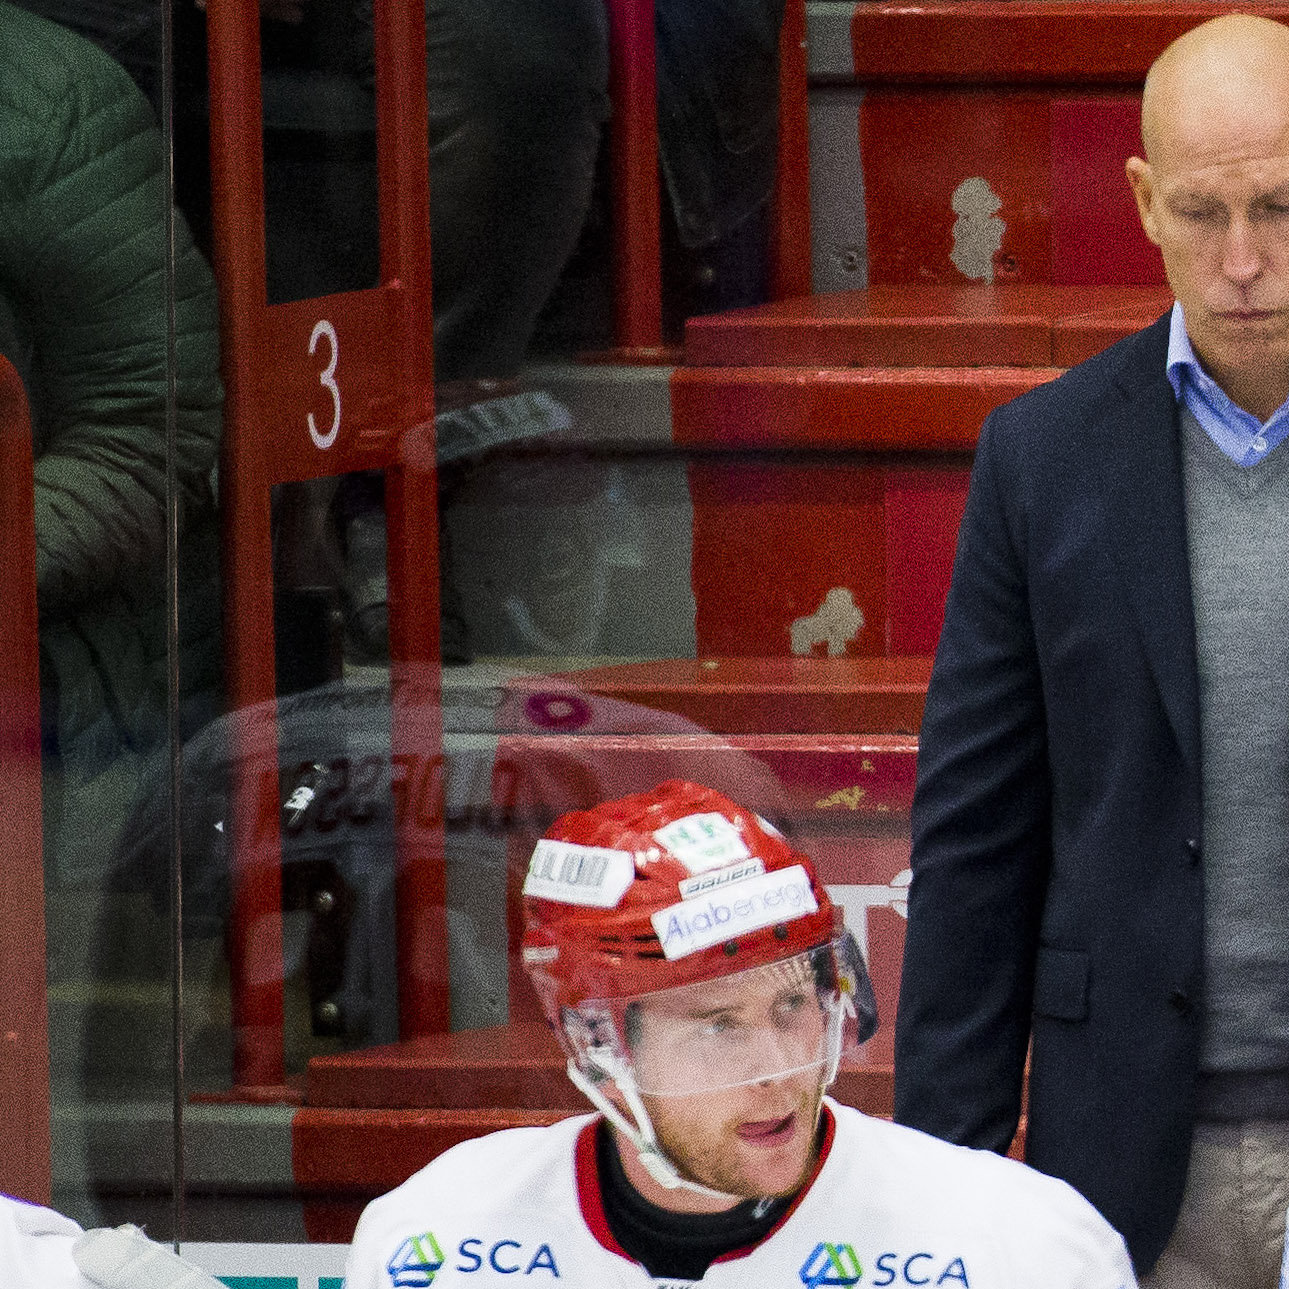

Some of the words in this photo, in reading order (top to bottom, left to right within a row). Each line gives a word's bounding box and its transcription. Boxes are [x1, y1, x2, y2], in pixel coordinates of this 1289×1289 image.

[307, 320, 341, 449] 3
[456, 1238, 561, 1279] SCA
[872, 1252, 970, 1289] SCA
